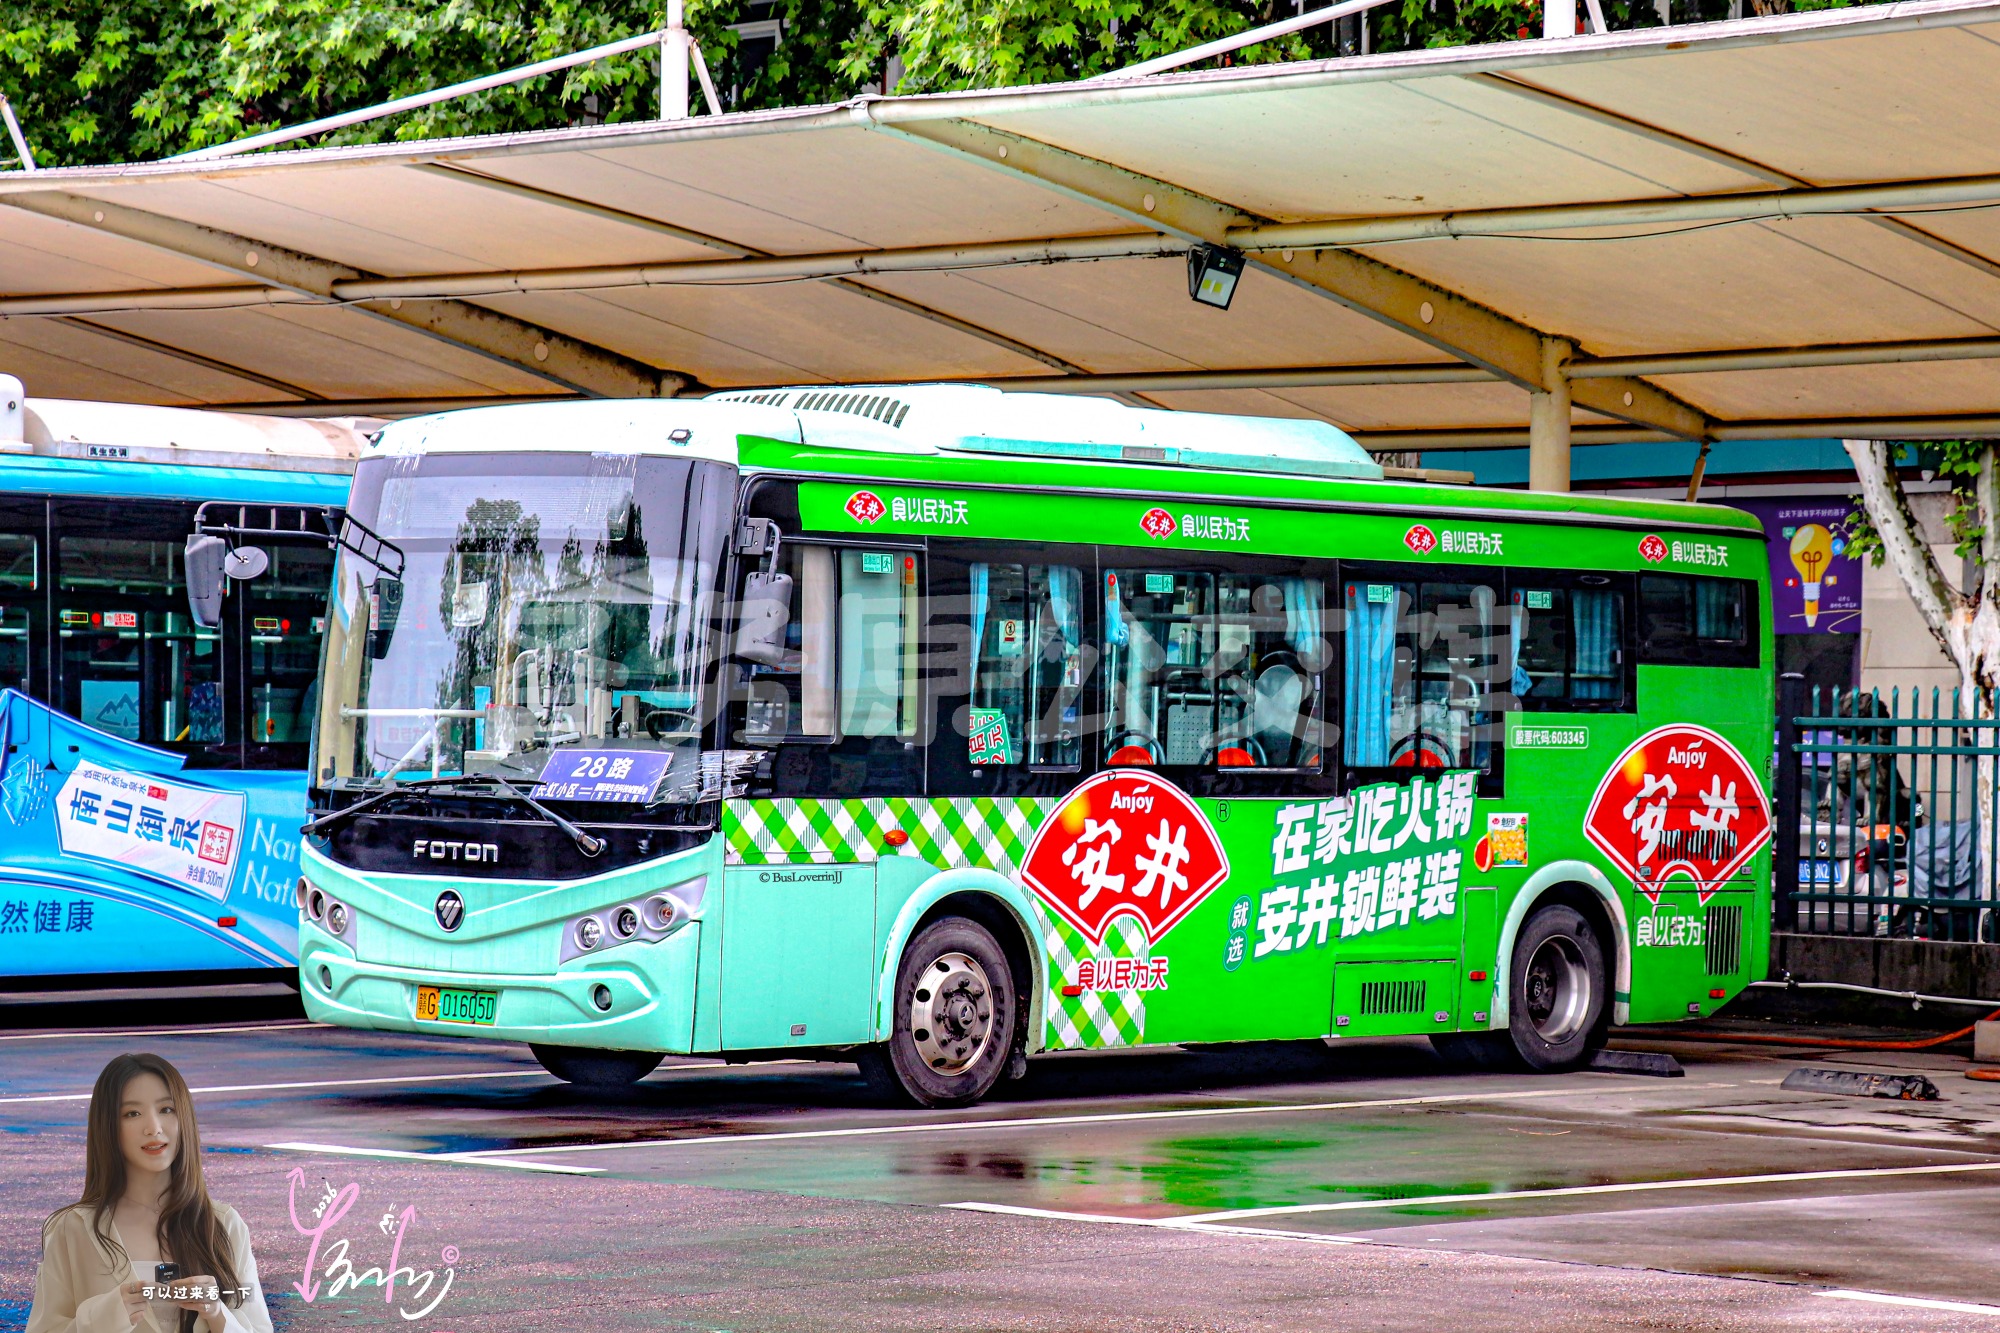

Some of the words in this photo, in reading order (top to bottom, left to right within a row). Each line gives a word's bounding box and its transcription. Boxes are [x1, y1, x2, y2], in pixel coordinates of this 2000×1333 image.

[892, 497, 968, 524] 食以民为天
[1182, 515, 1250, 541] 食以民为天
[1441, 531, 1503, 556] 食以民为天
[1672, 541, 1728, 567] 食以民为天
[571, 757, 635, 779] 28路
[1668, 743, 1708, 769] Anjoy
[1110, 787, 1154, 813] Anjoy
[70, 788, 201, 855] 南山御泉
[1273, 771, 1478, 875] 在家吃火锅
[1623, 774, 1740, 865] 安井
[413, 840, 499, 862] FOTON
[1062, 818, 1190, 910] 安井
[0, 899, 94, 933] 然健康
[1254, 850, 1462, 957] 安井锁鲜装
[1226, 901, 1249, 964] 就选
[1079, 957, 1168, 990] 食以民为天
